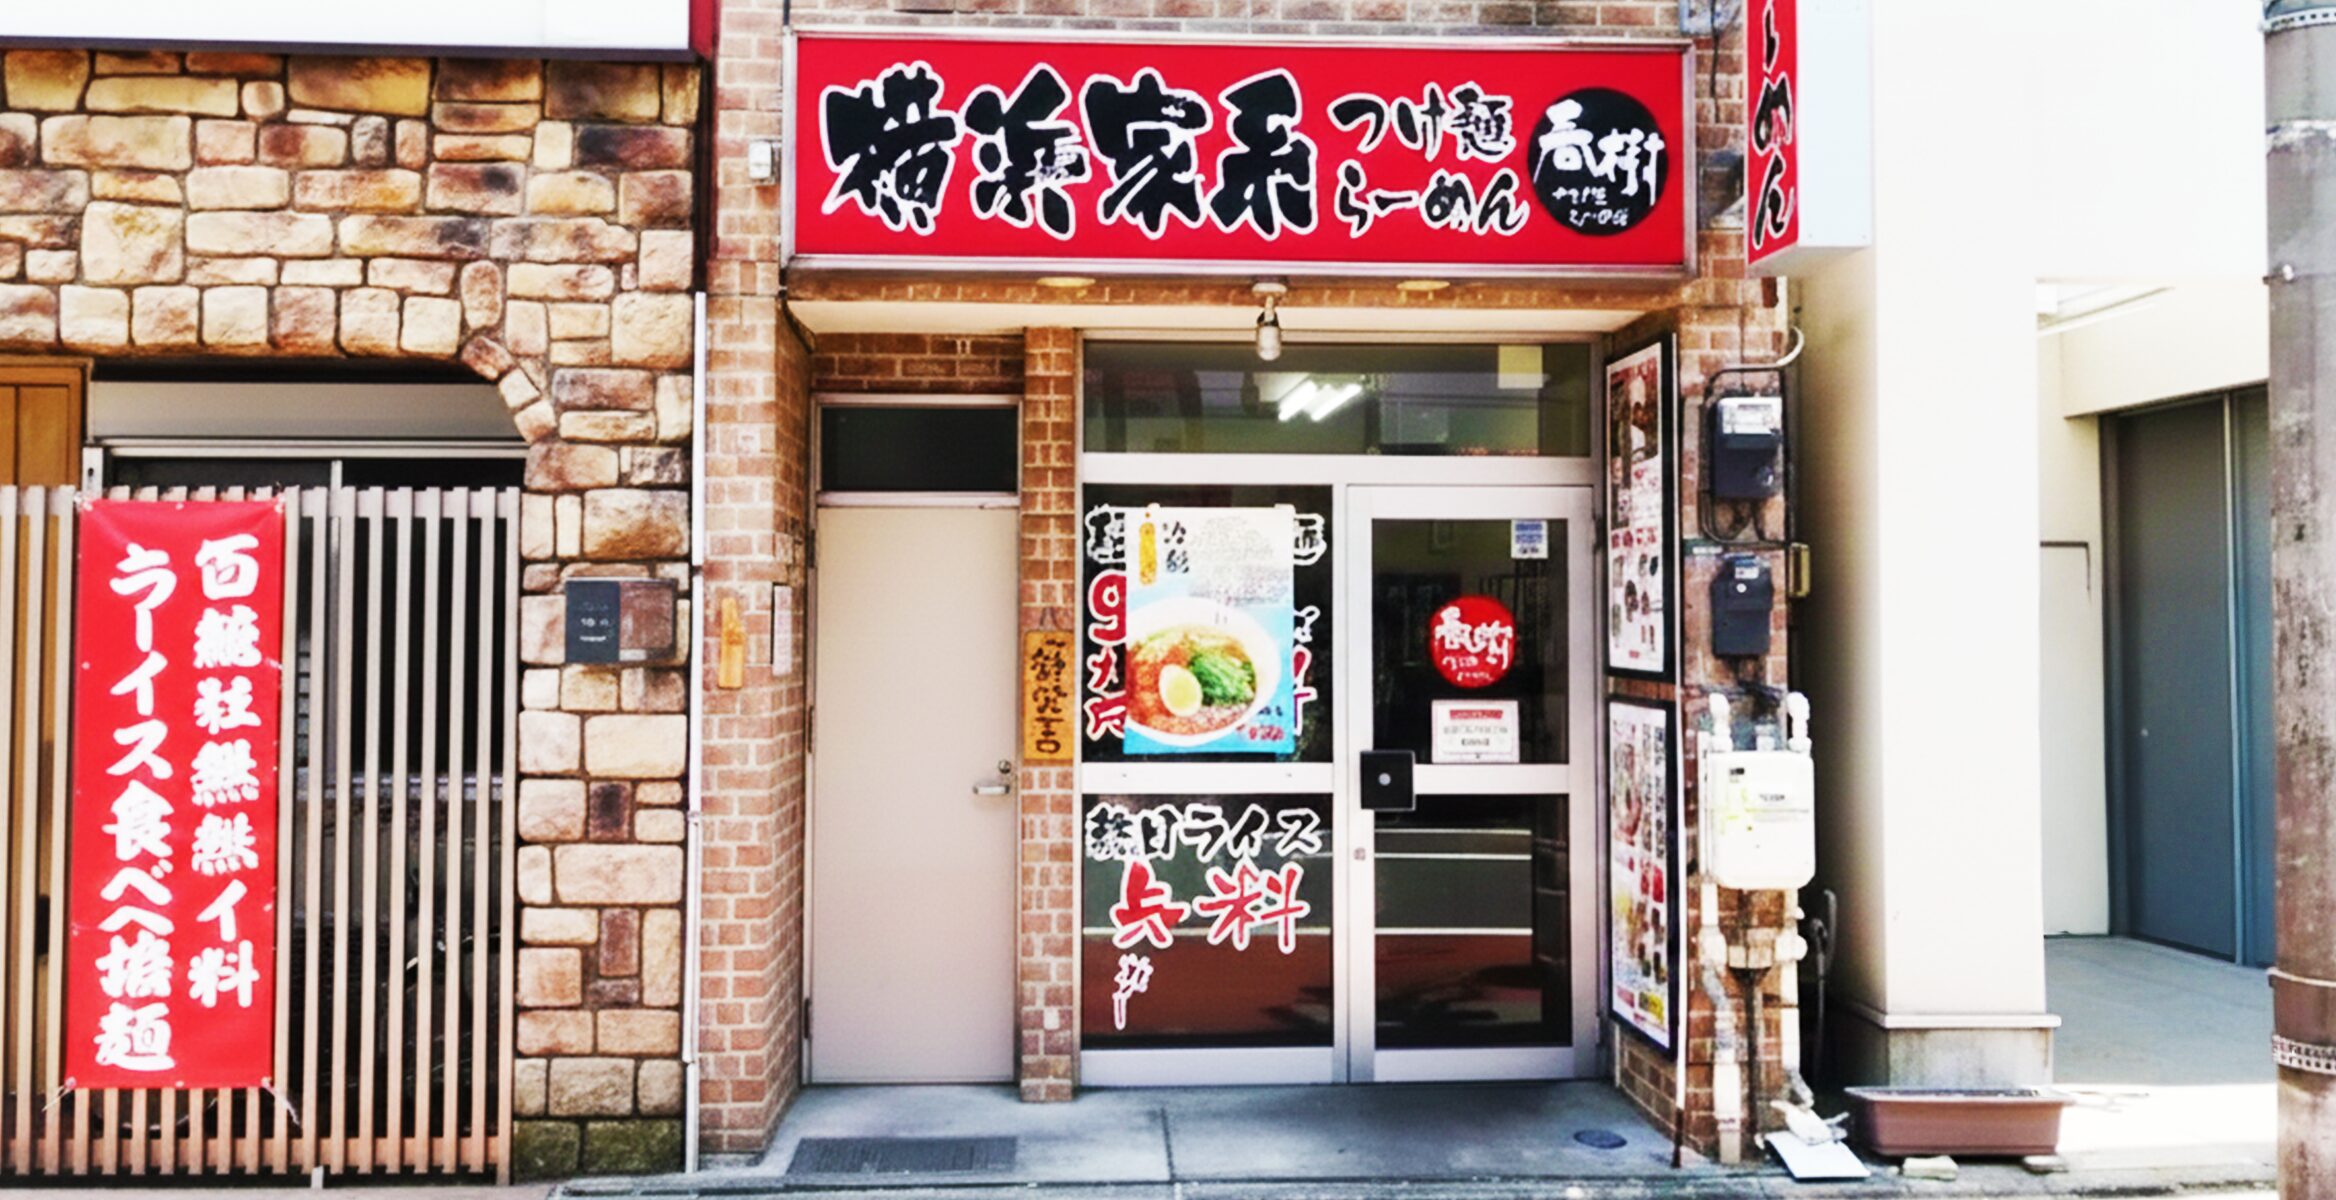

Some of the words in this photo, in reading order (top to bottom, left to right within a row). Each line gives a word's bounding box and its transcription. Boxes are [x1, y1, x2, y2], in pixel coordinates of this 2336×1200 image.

[819, 60, 1319, 242] 横浜家系
[1327, 81, 1517, 164] つけ麺
[1335, 159, 1530, 238] らーめん
